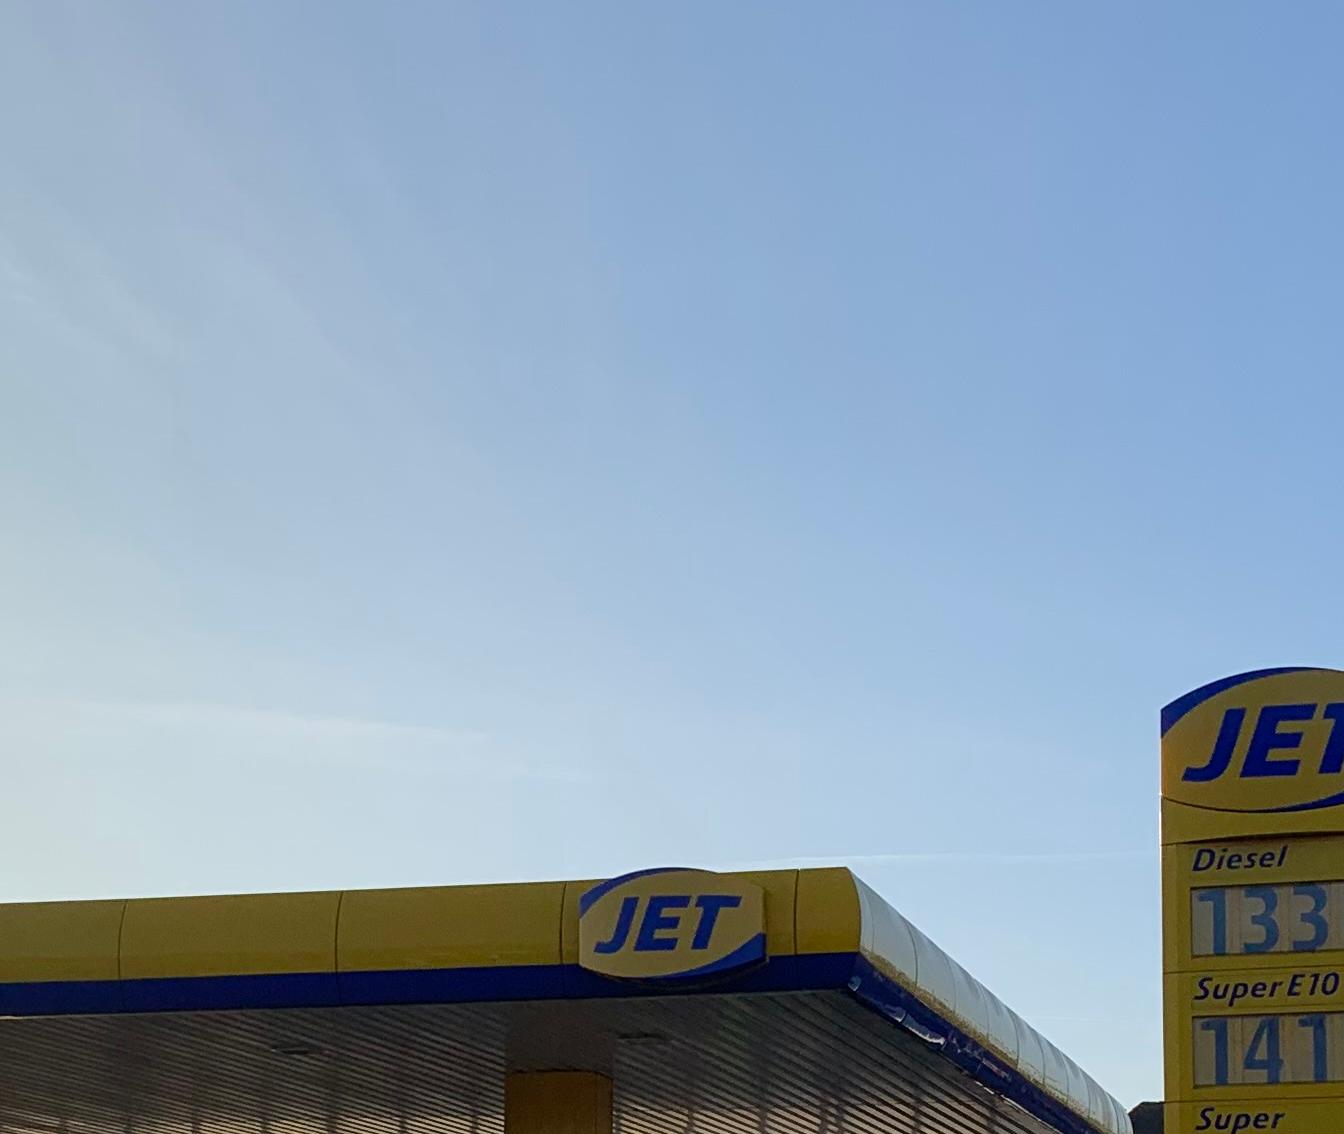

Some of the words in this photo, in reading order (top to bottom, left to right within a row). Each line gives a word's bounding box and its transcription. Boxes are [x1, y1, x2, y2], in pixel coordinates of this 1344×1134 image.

[1192, 845, 1288, 872] Diesel
[593, 894, 742, 954] JET
[1193, 977, 1283, 1006] Super
[1287, 972, 1340, 996] E10
